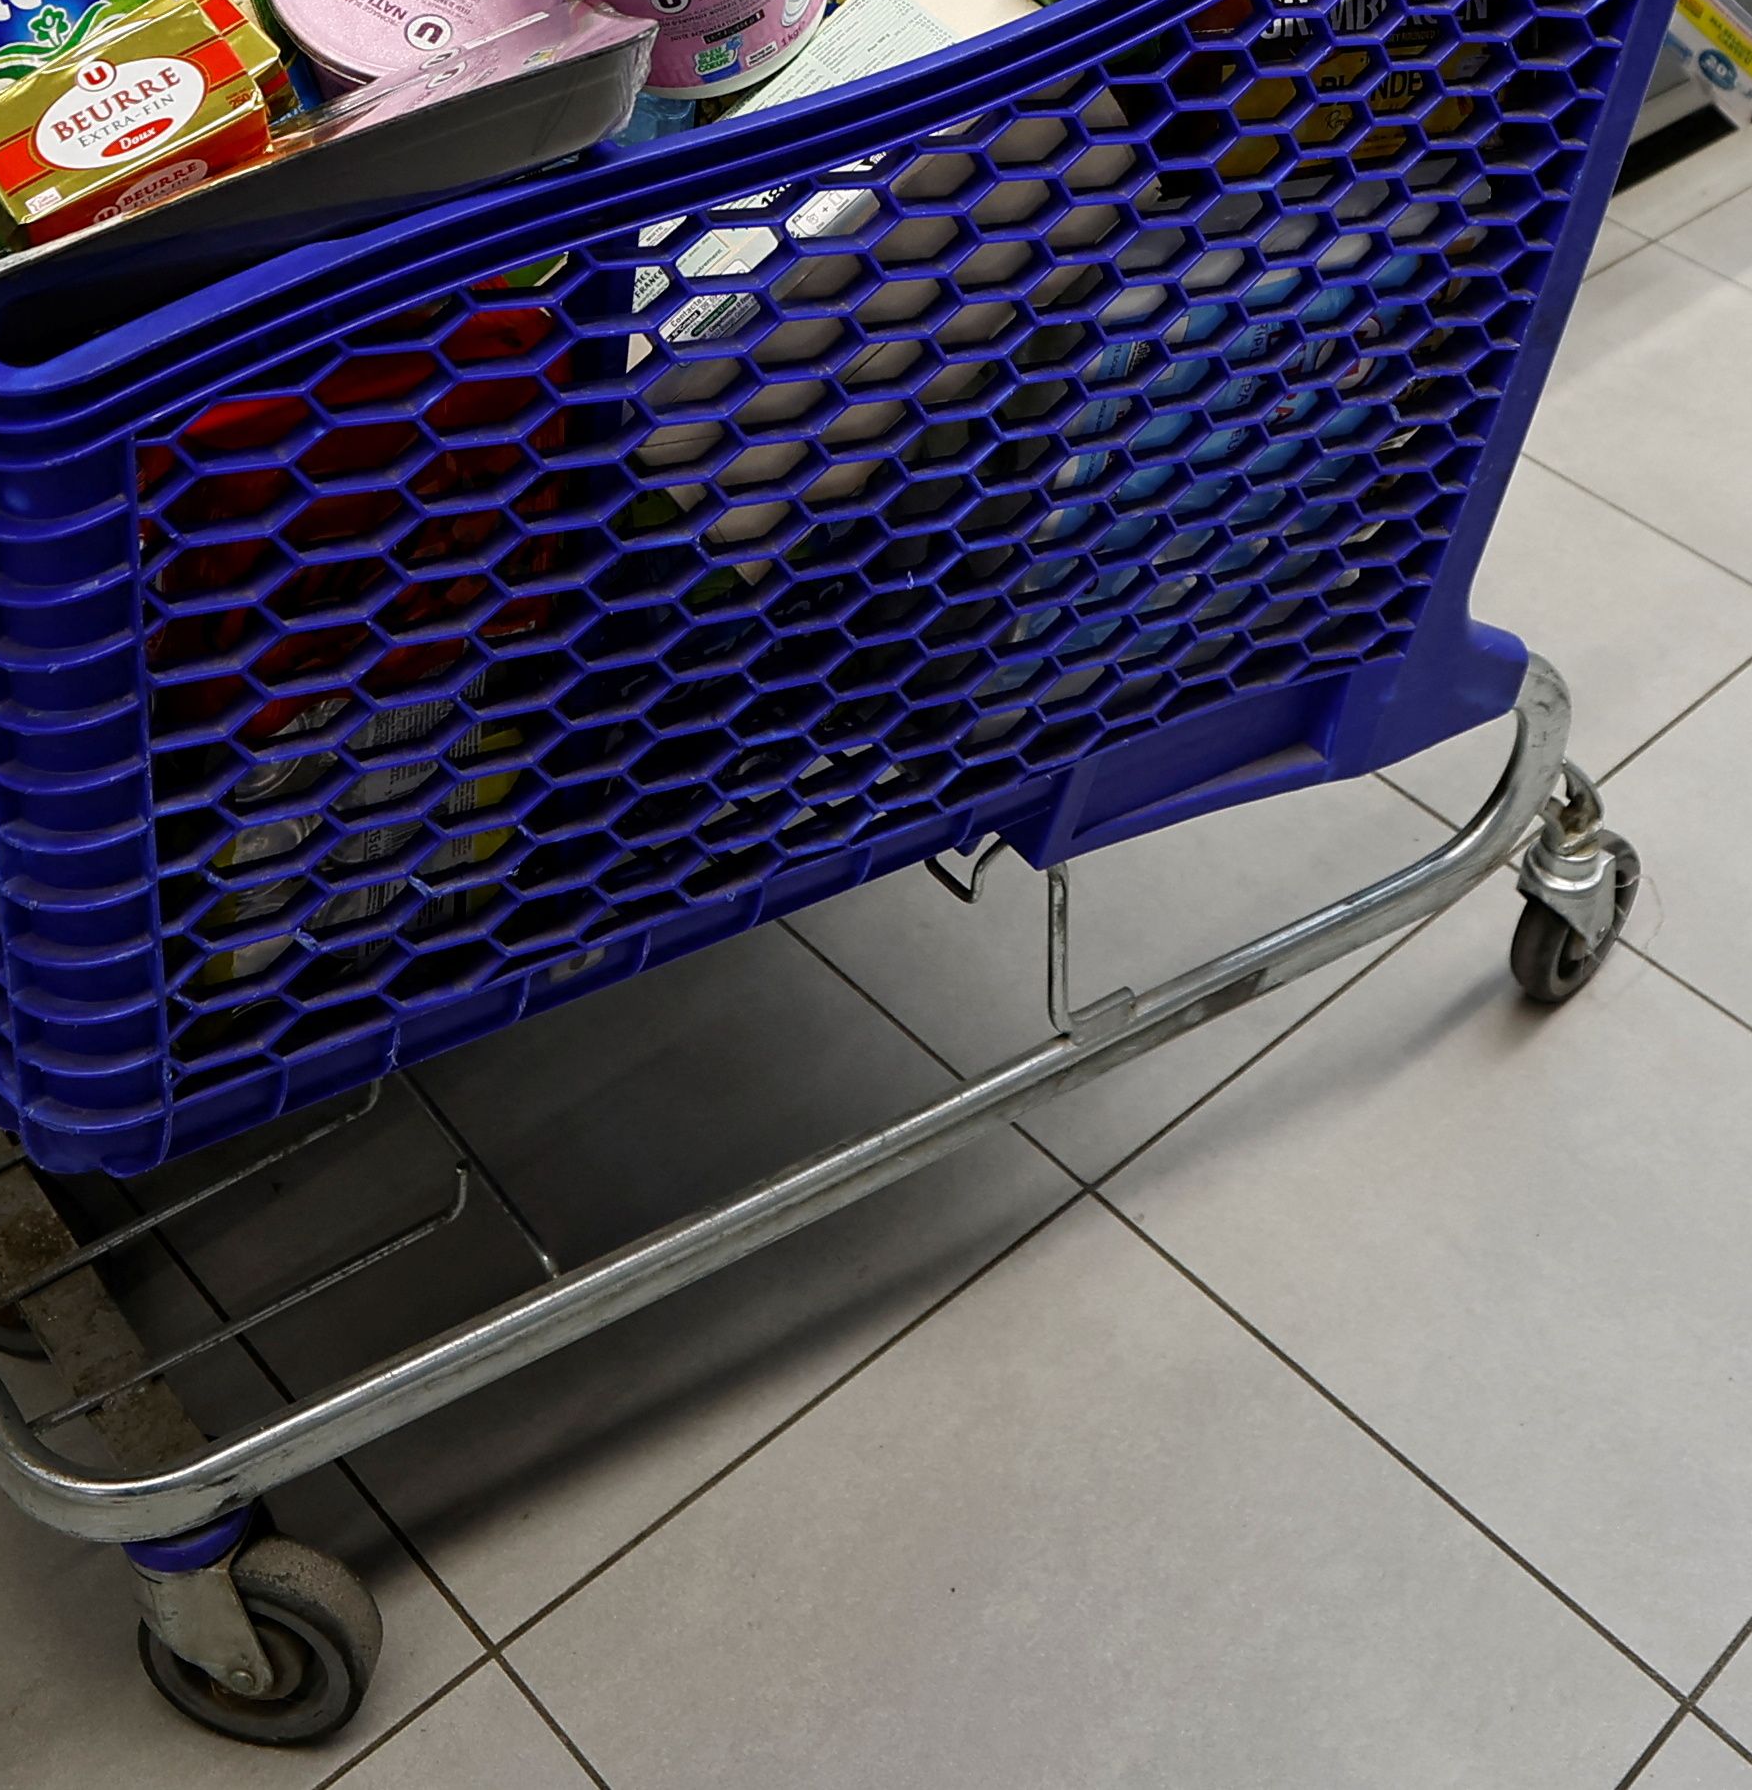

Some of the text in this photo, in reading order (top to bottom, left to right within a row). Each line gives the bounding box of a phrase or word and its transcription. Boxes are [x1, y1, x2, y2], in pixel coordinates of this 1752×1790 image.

[84, 67, 108, 86] U
[50, 65, 181, 144] BEURRE
[77, 91, 176, 149] EXTRA-FIN
[117, 124, 159, 154] Doux
[117, 159, 200, 208] BEURRE
